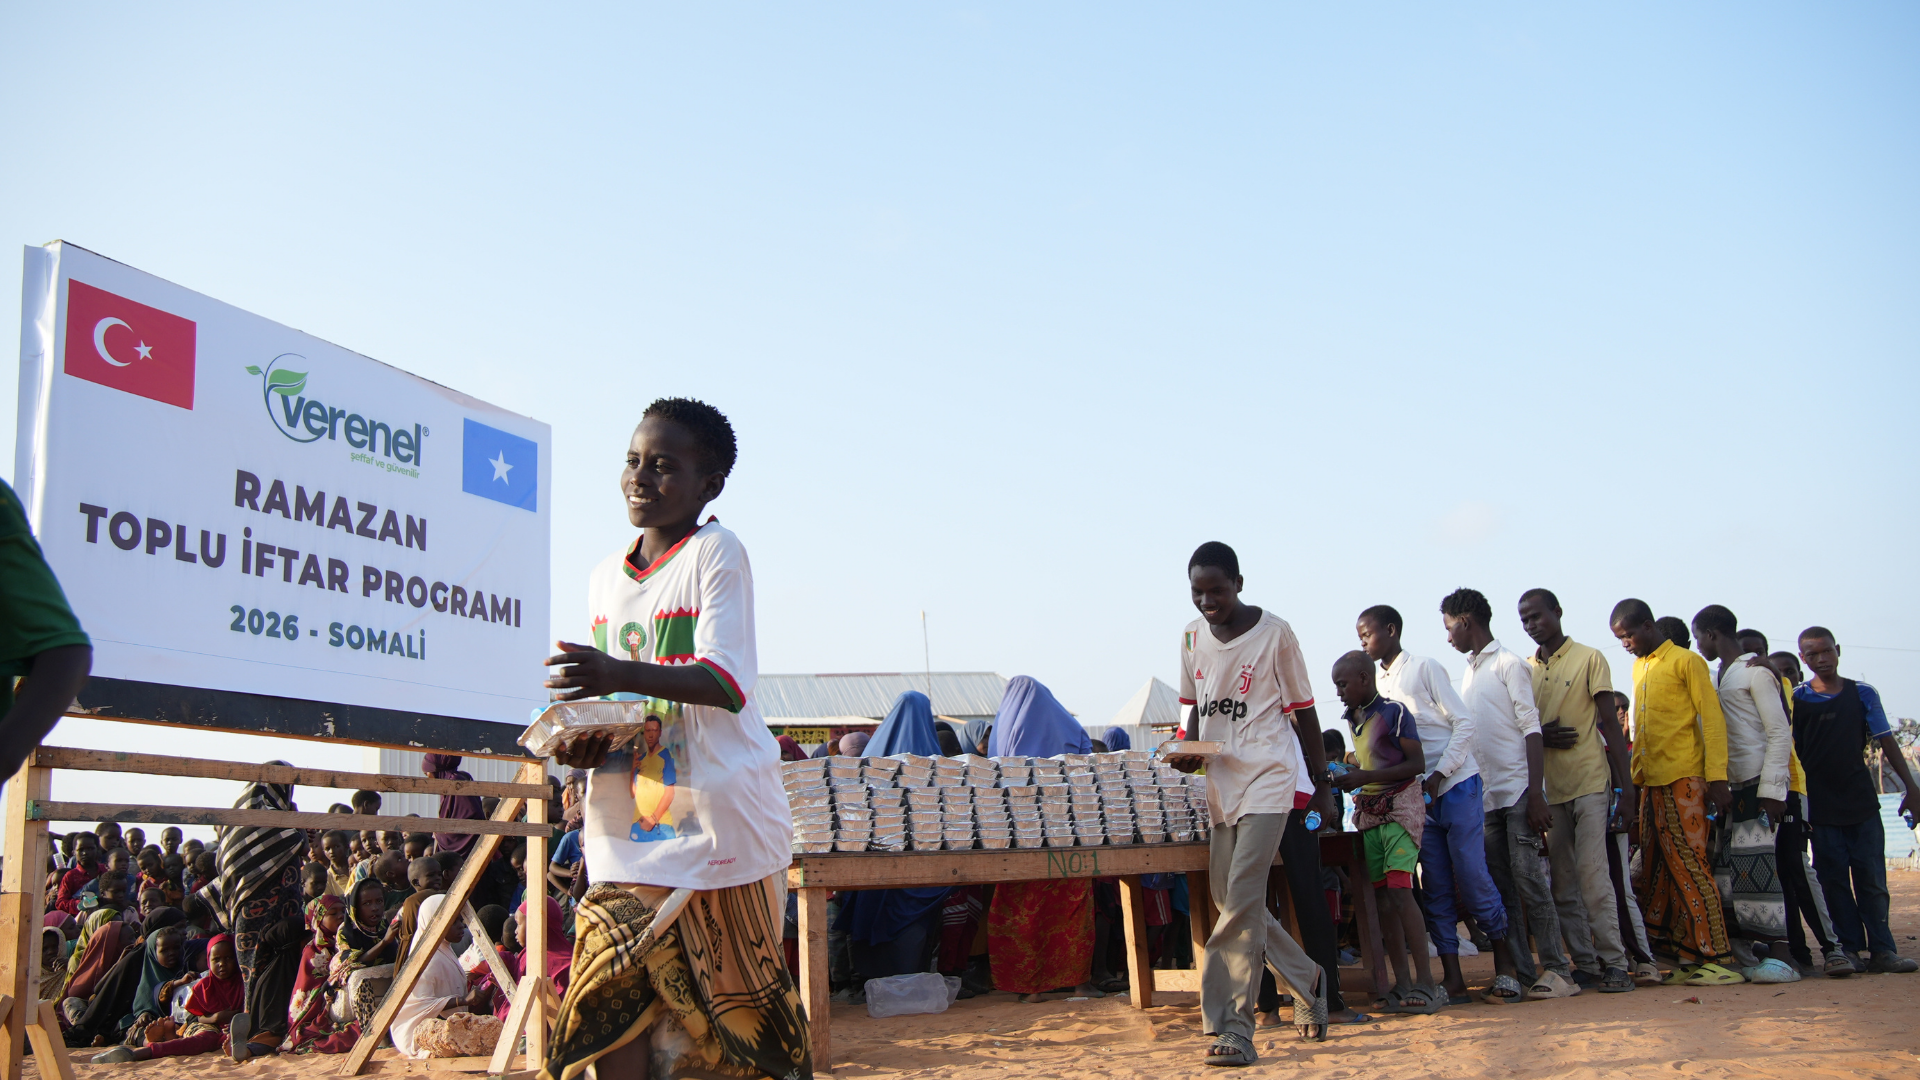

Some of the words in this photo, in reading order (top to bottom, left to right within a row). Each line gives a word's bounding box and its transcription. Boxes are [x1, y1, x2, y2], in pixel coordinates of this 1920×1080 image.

[350, 452, 374, 463] şeffaf
[375, 460, 385, 468] ve
[386, 463, 420, 479] güvenilir
[235, 469, 427, 551] RAMAZAN
[79, 502, 226, 567] TOPLU
[241, 526, 349, 593] İFTAR
[363, 566, 521, 628] PROGRAMI
[230, 605, 299, 641] 2026
[328, 622, 426, 660] SOMALİ
[1200, 693, 1248, 721] Jeep
[707, 857, 737, 866] AEROREADY
